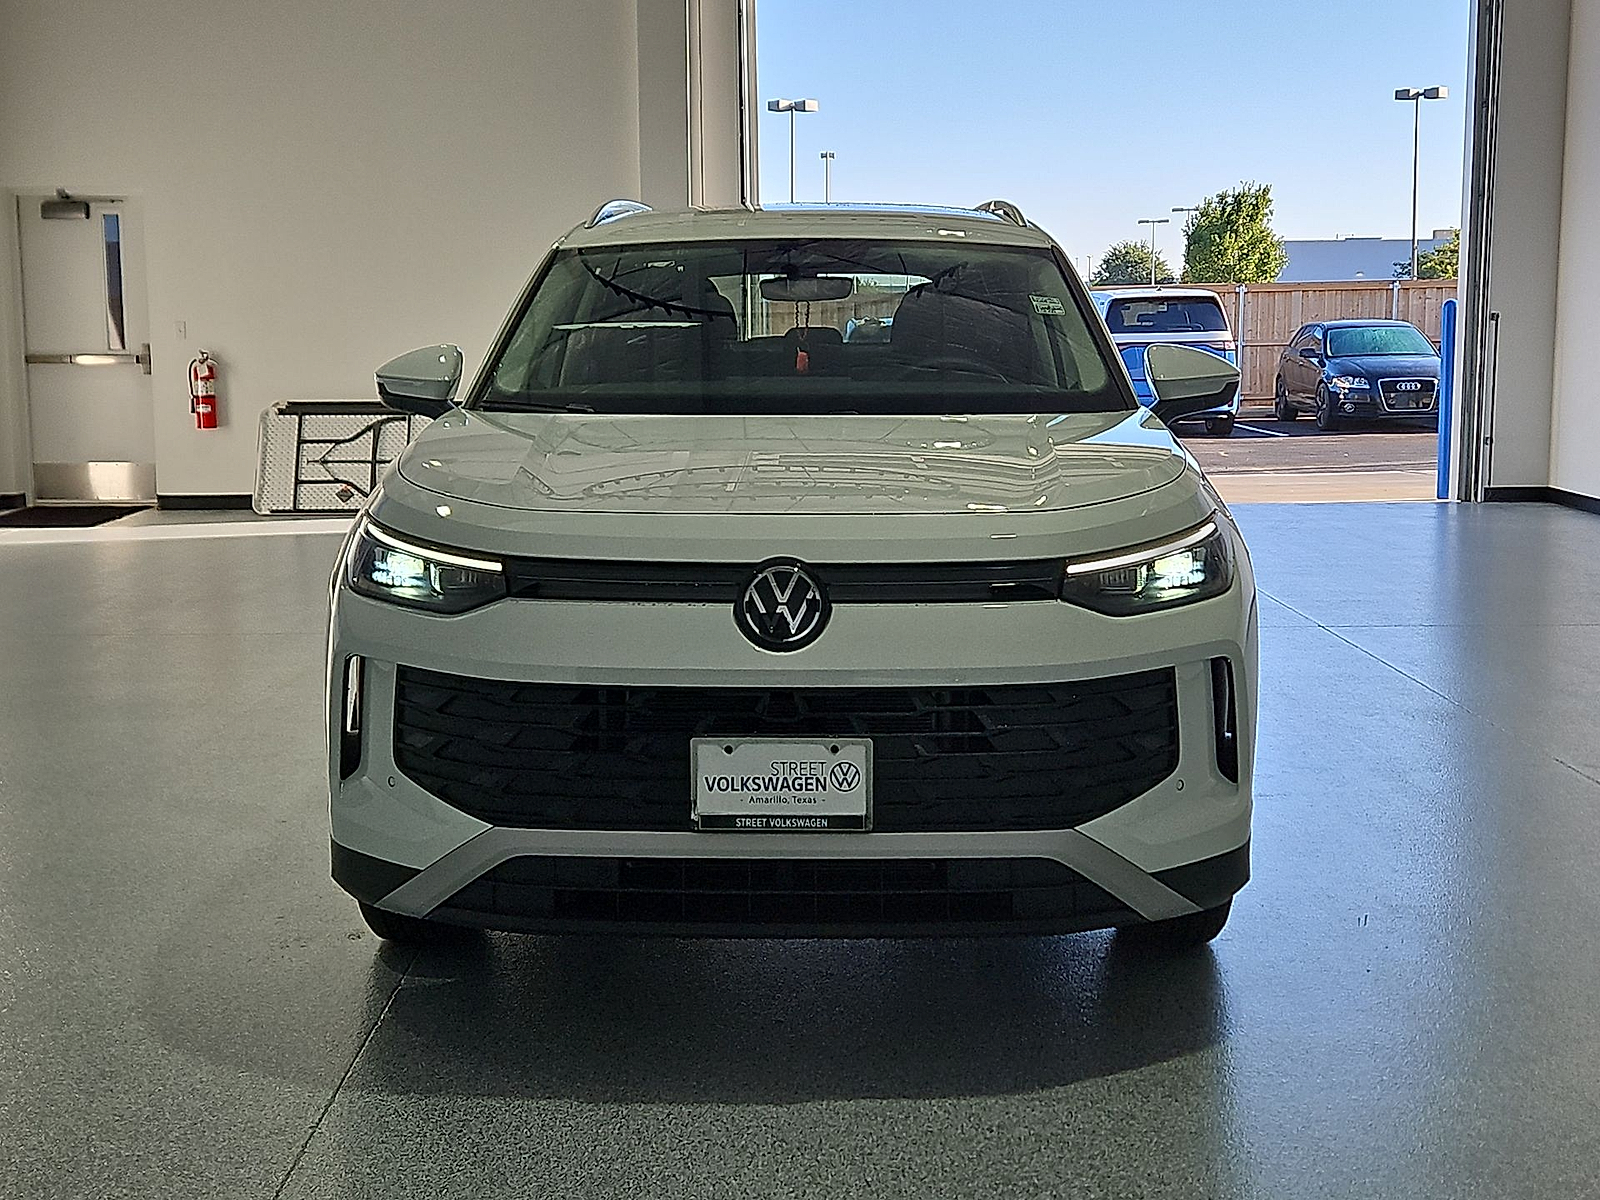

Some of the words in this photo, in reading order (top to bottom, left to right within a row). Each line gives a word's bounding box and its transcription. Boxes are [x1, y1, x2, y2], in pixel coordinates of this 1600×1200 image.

[770, 761, 827, 776] STREET
[704, 776, 828, 792] VOLKSWAGEN
[748, 795, 790, 805] Amarillo,
[792, 796, 817, 804] Texas
[735, 818, 767, 827] STREET
[769, 818, 828, 827] VOLKSWAGEN
